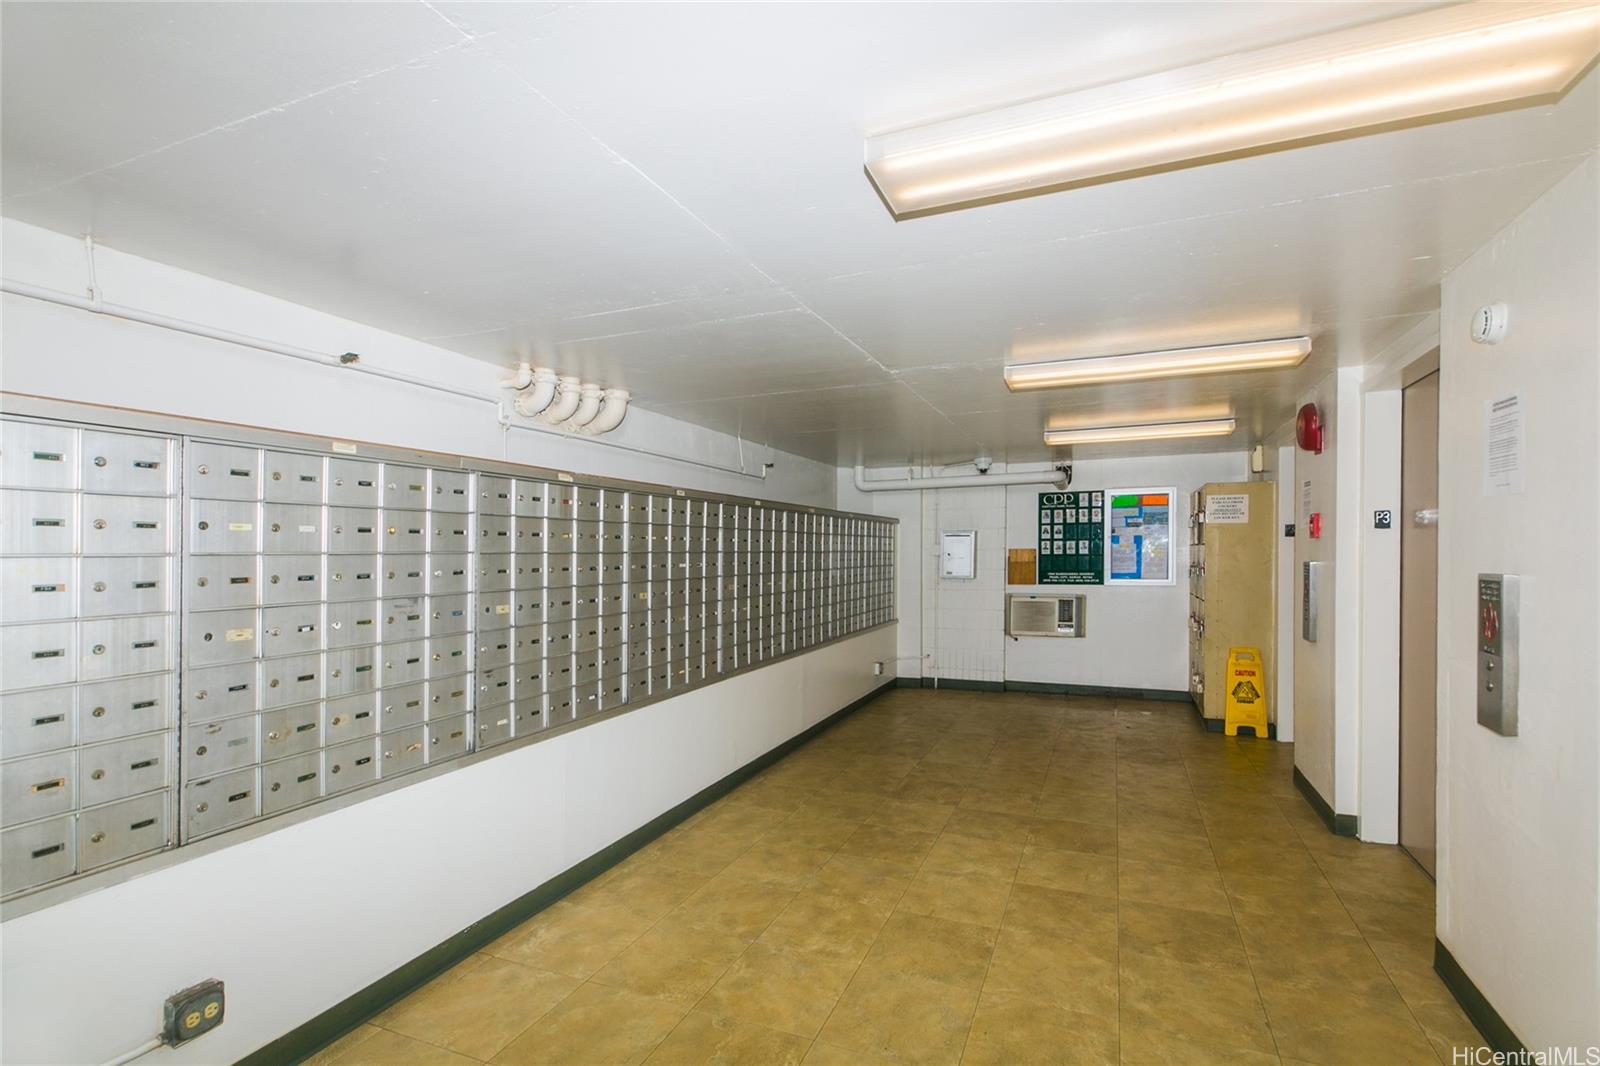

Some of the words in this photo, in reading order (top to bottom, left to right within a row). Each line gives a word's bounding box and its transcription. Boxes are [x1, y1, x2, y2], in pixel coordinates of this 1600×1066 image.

[1043, 493, 1074, 505] CPP
[1375, 511, 1390, 524] P3
[1235, 669, 1256, 677] CAUTION
